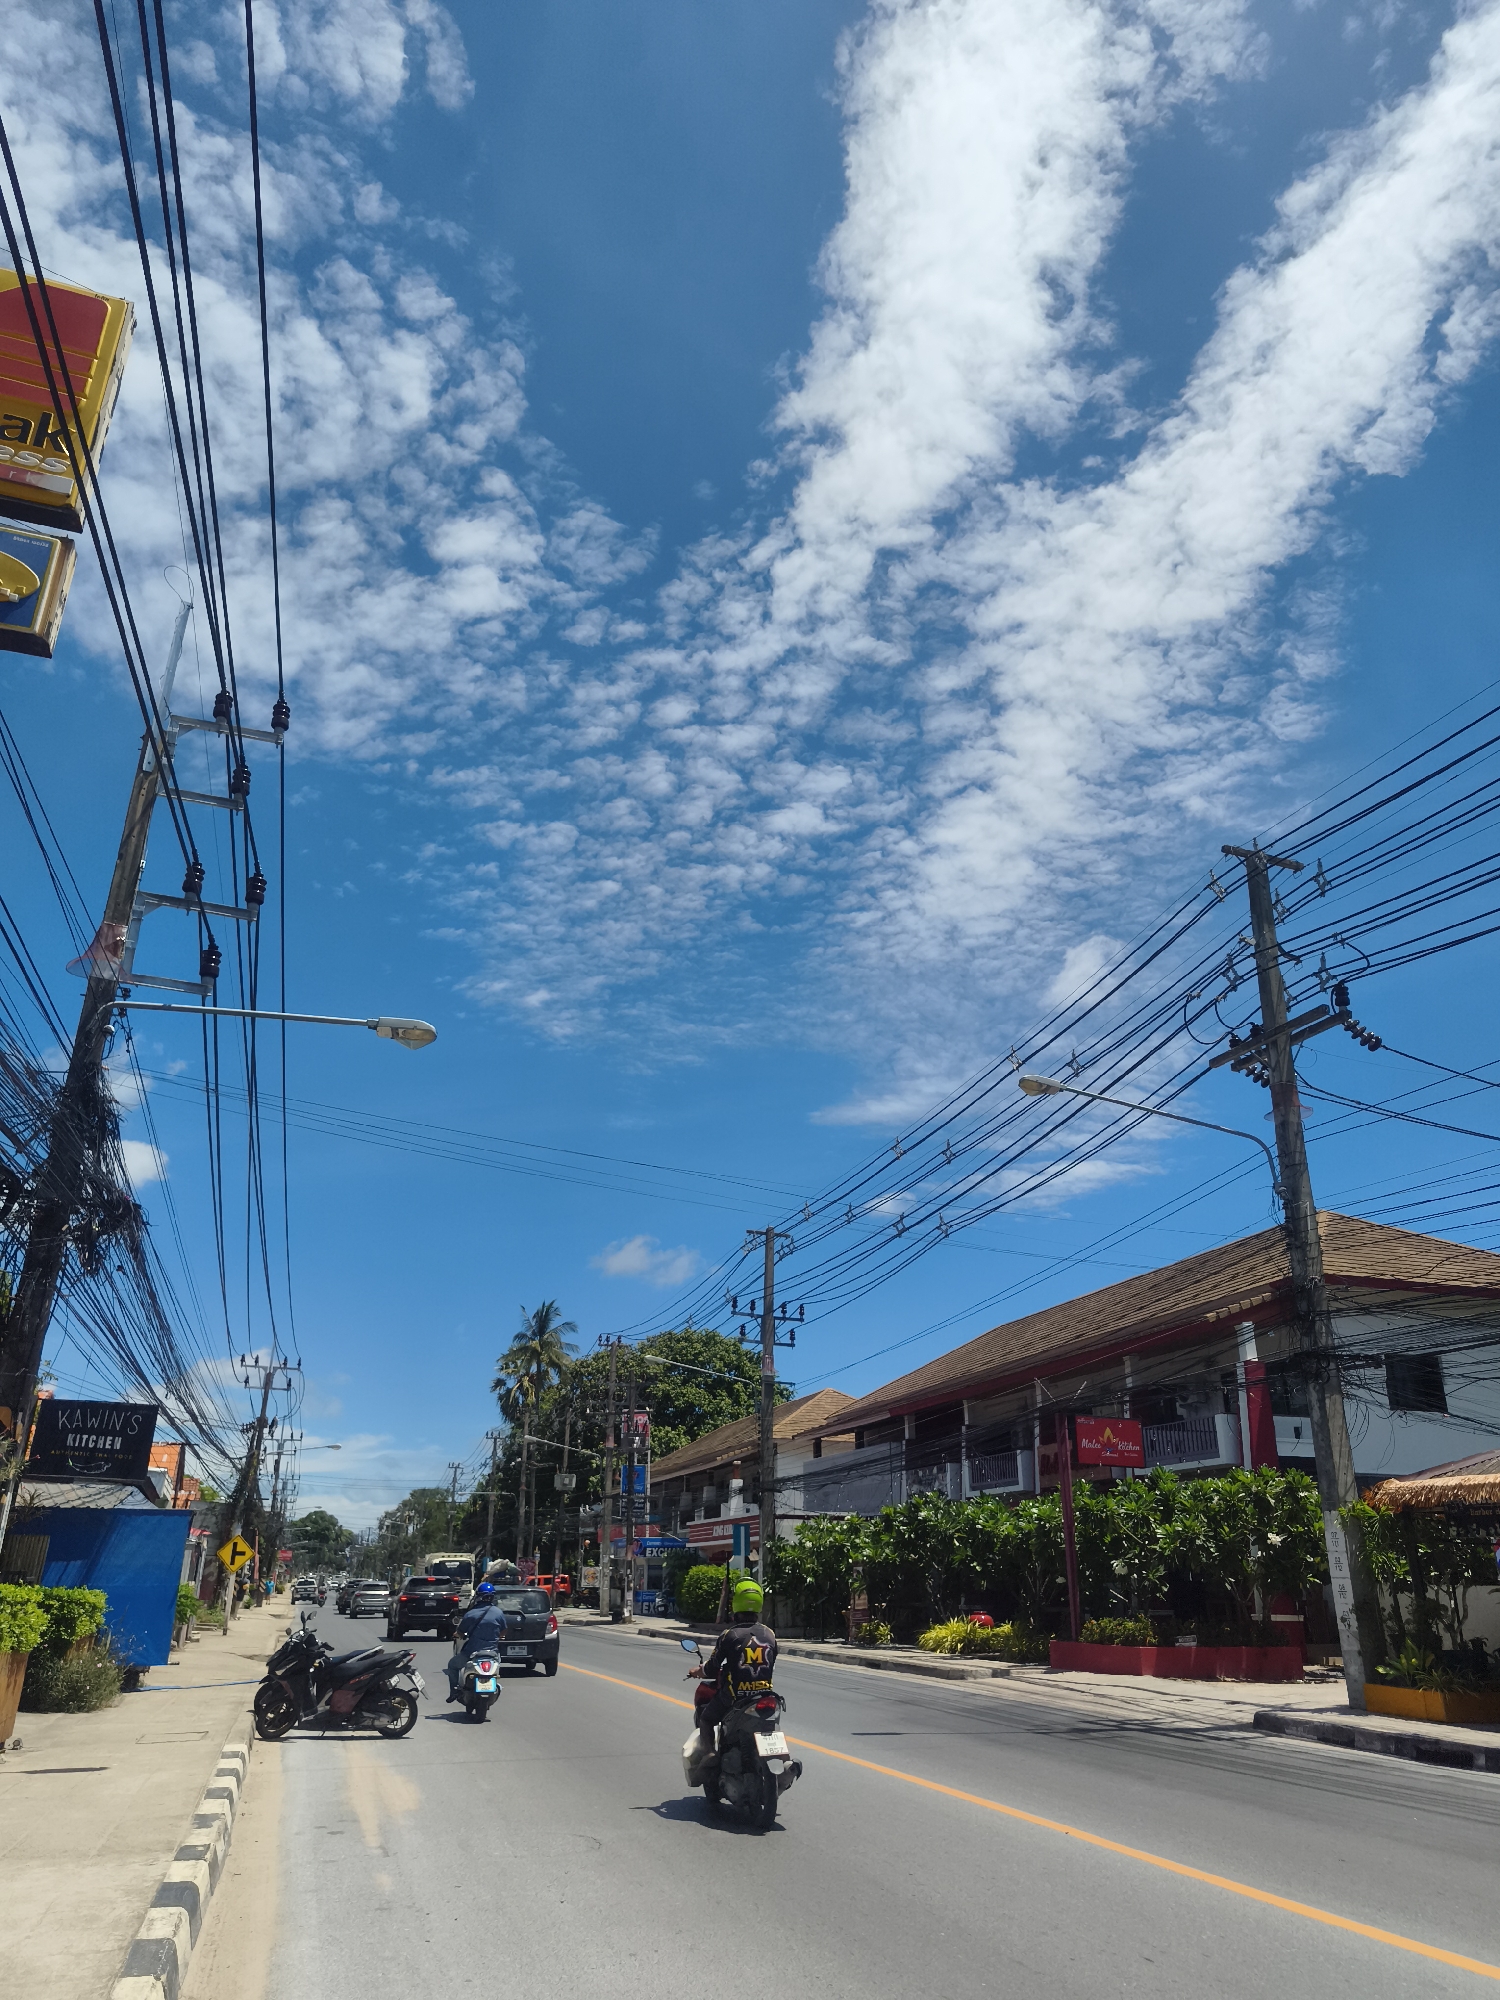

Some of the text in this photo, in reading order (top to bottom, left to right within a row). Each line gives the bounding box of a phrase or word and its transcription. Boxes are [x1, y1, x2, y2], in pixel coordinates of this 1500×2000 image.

[58, 1408, 142, 1435] KAWIN'S
[66, 1433, 123, 1450] KITCHEN
[745, 1647, 764, 1664] M
